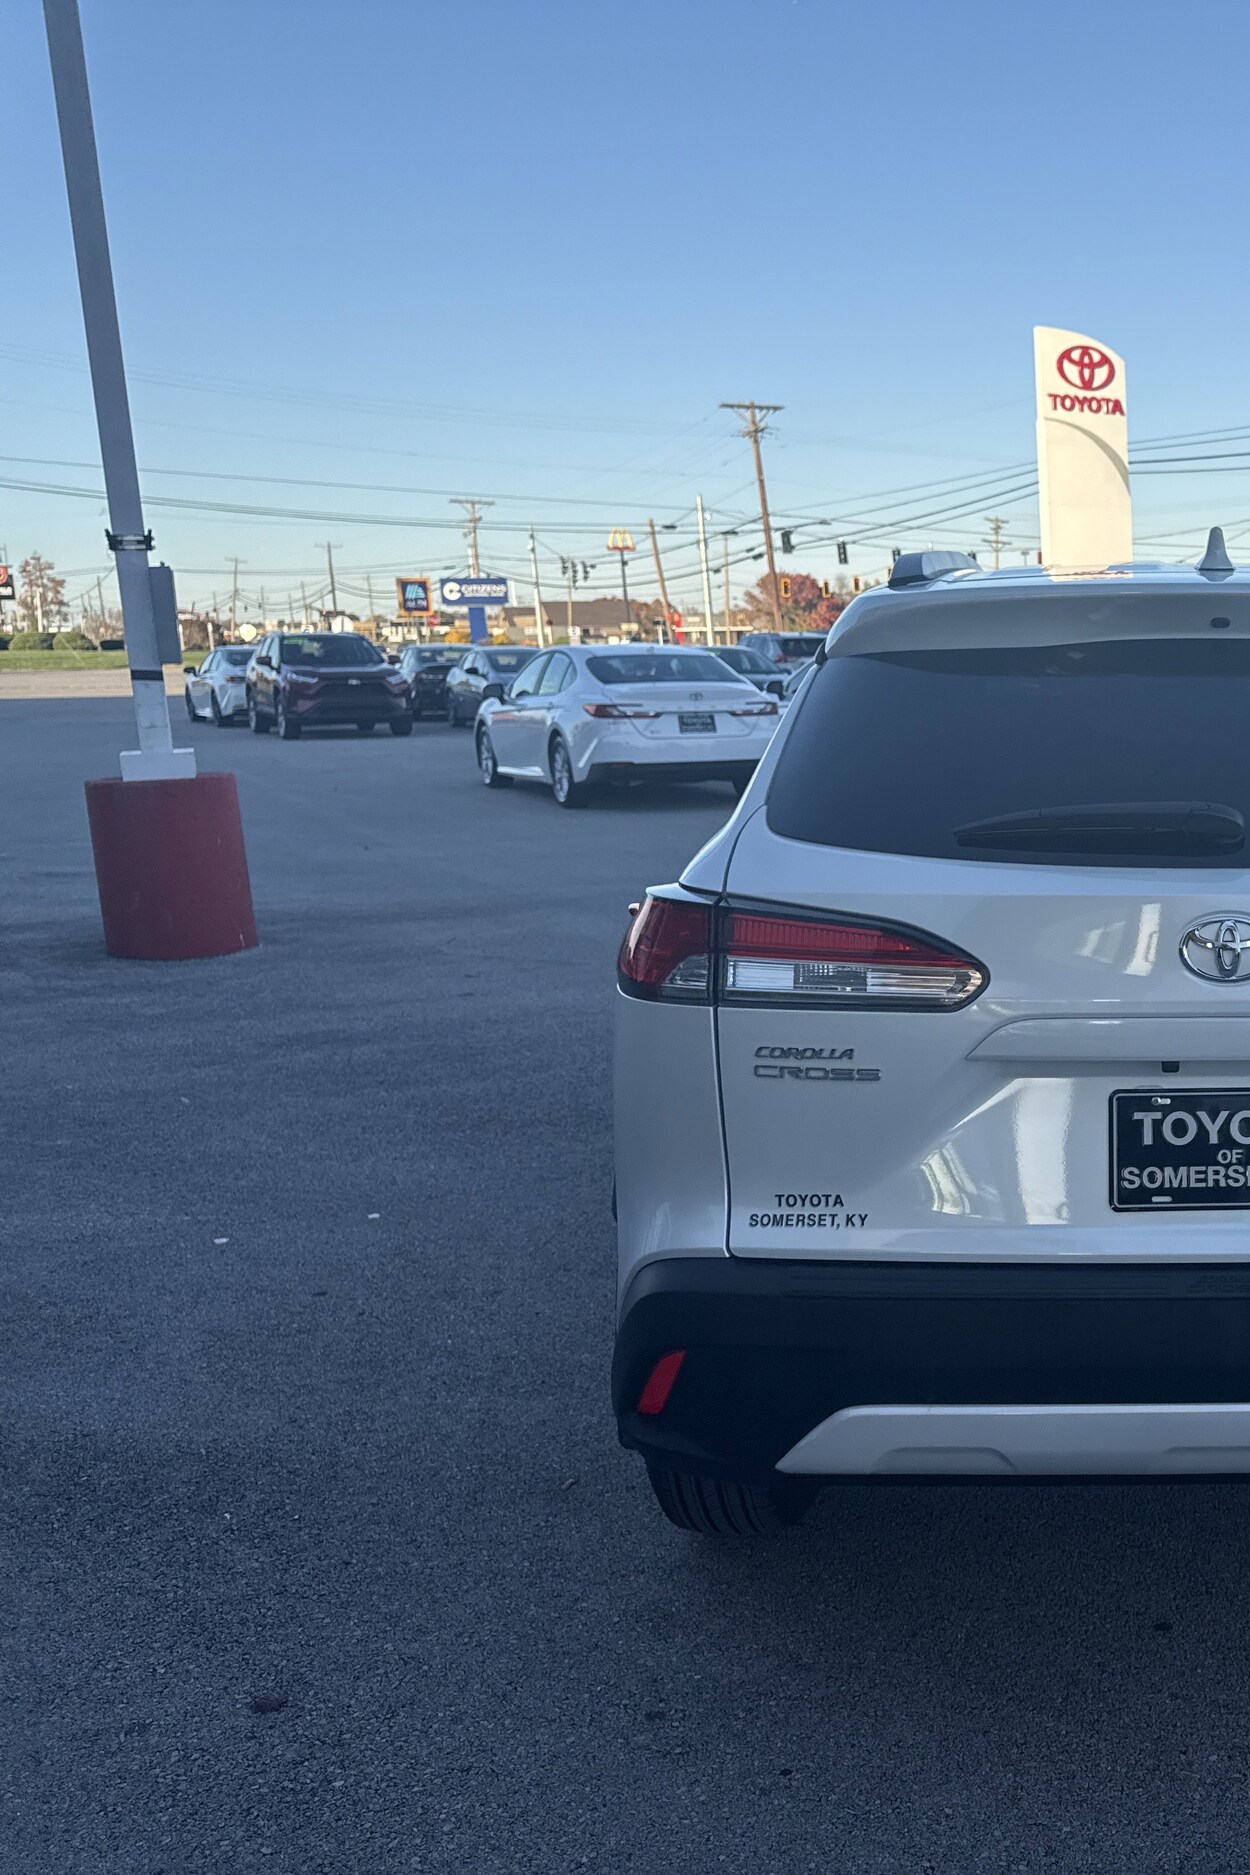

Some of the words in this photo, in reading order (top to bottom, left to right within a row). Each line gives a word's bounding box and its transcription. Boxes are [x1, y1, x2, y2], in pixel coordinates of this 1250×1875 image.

[1048, 393, 1125, 416] TOYOTA
[461, 583, 507, 593] CITIZENS
[754, 1046, 855, 1060] COROLLA
[754, 1065, 881, 1081] CROSS
[1217, 1149, 1243, 1164] OF
[775, 1194, 844, 1208] TOYOTA
[749, 1213, 841, 1230] SOMERSET,
[845, 1213, 869, 1227] KY
